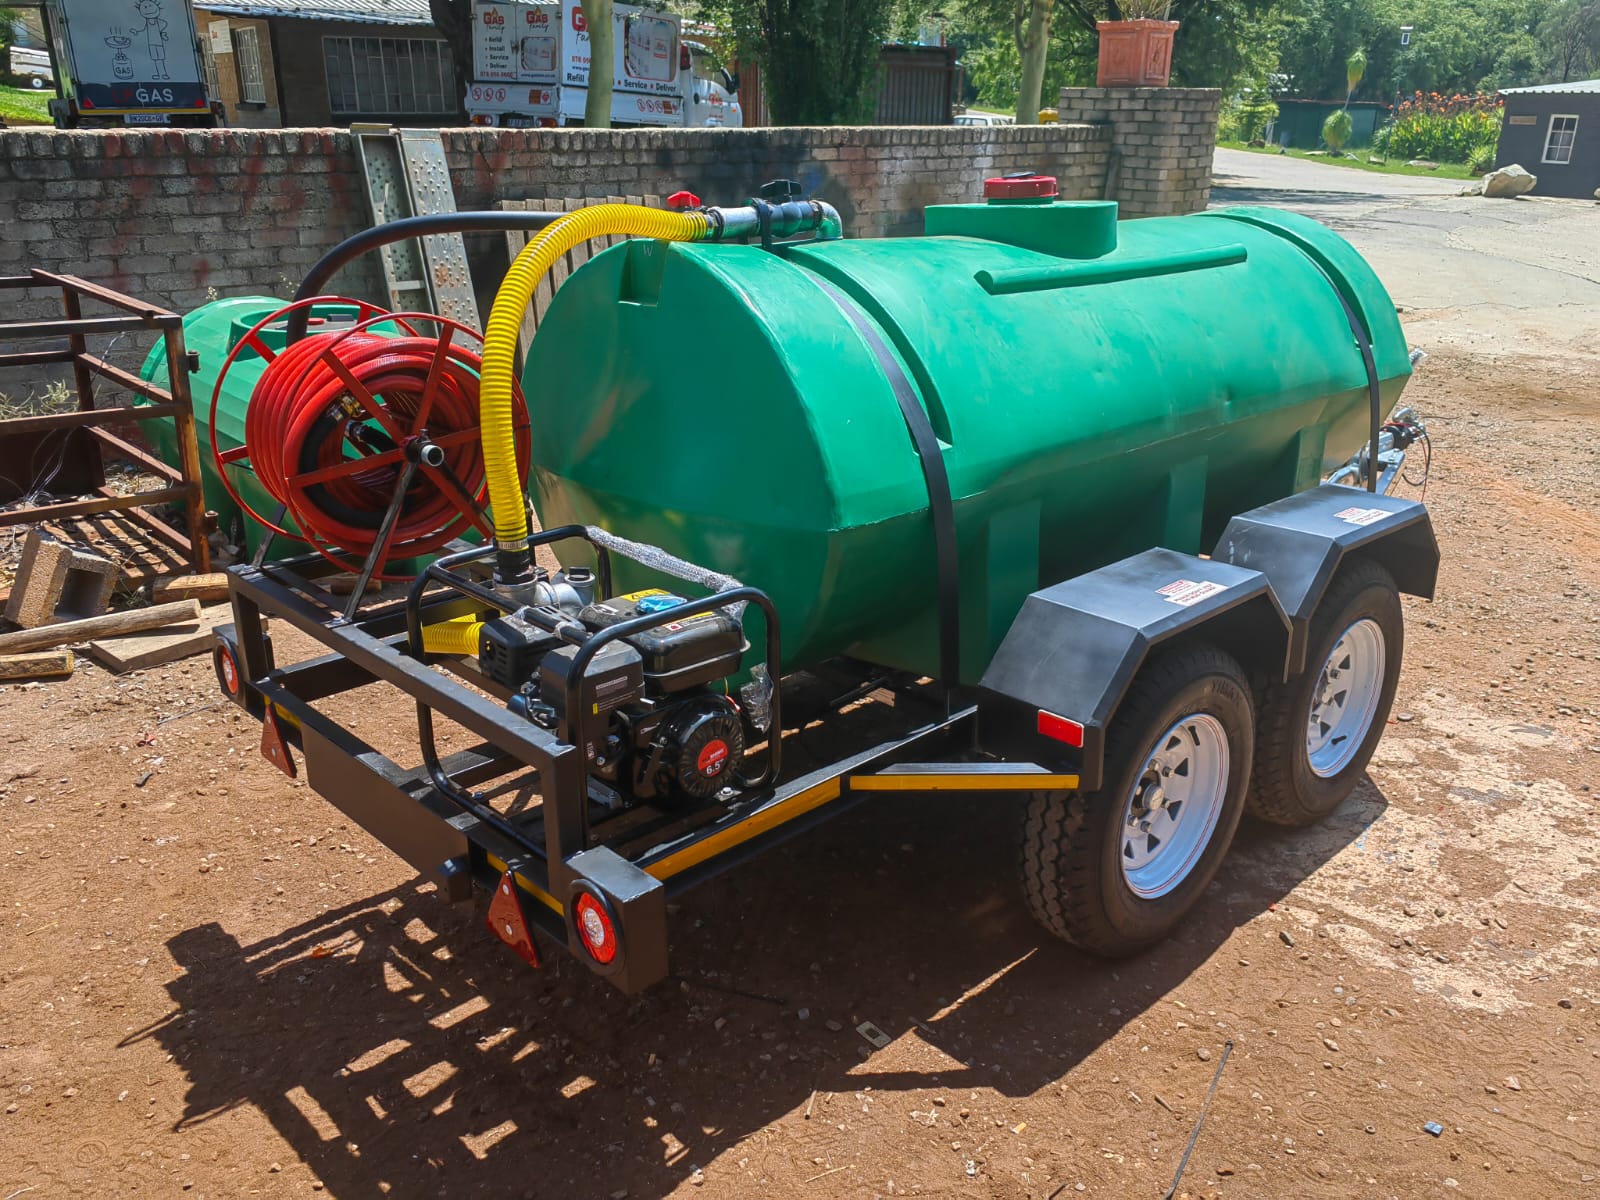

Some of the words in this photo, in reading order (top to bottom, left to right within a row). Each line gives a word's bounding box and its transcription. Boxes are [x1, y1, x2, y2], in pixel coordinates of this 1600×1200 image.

[483, 12, 505, 25] GAS
[527, 11, 548, 24] GAS
[115, 66, 132, 74] GAS
[566, 73, 585, 82] Refill
[624, 79, 648, 89] Service
[655, 83, 677, 92] Deliver
[136, 88, 174, 103] GAS
